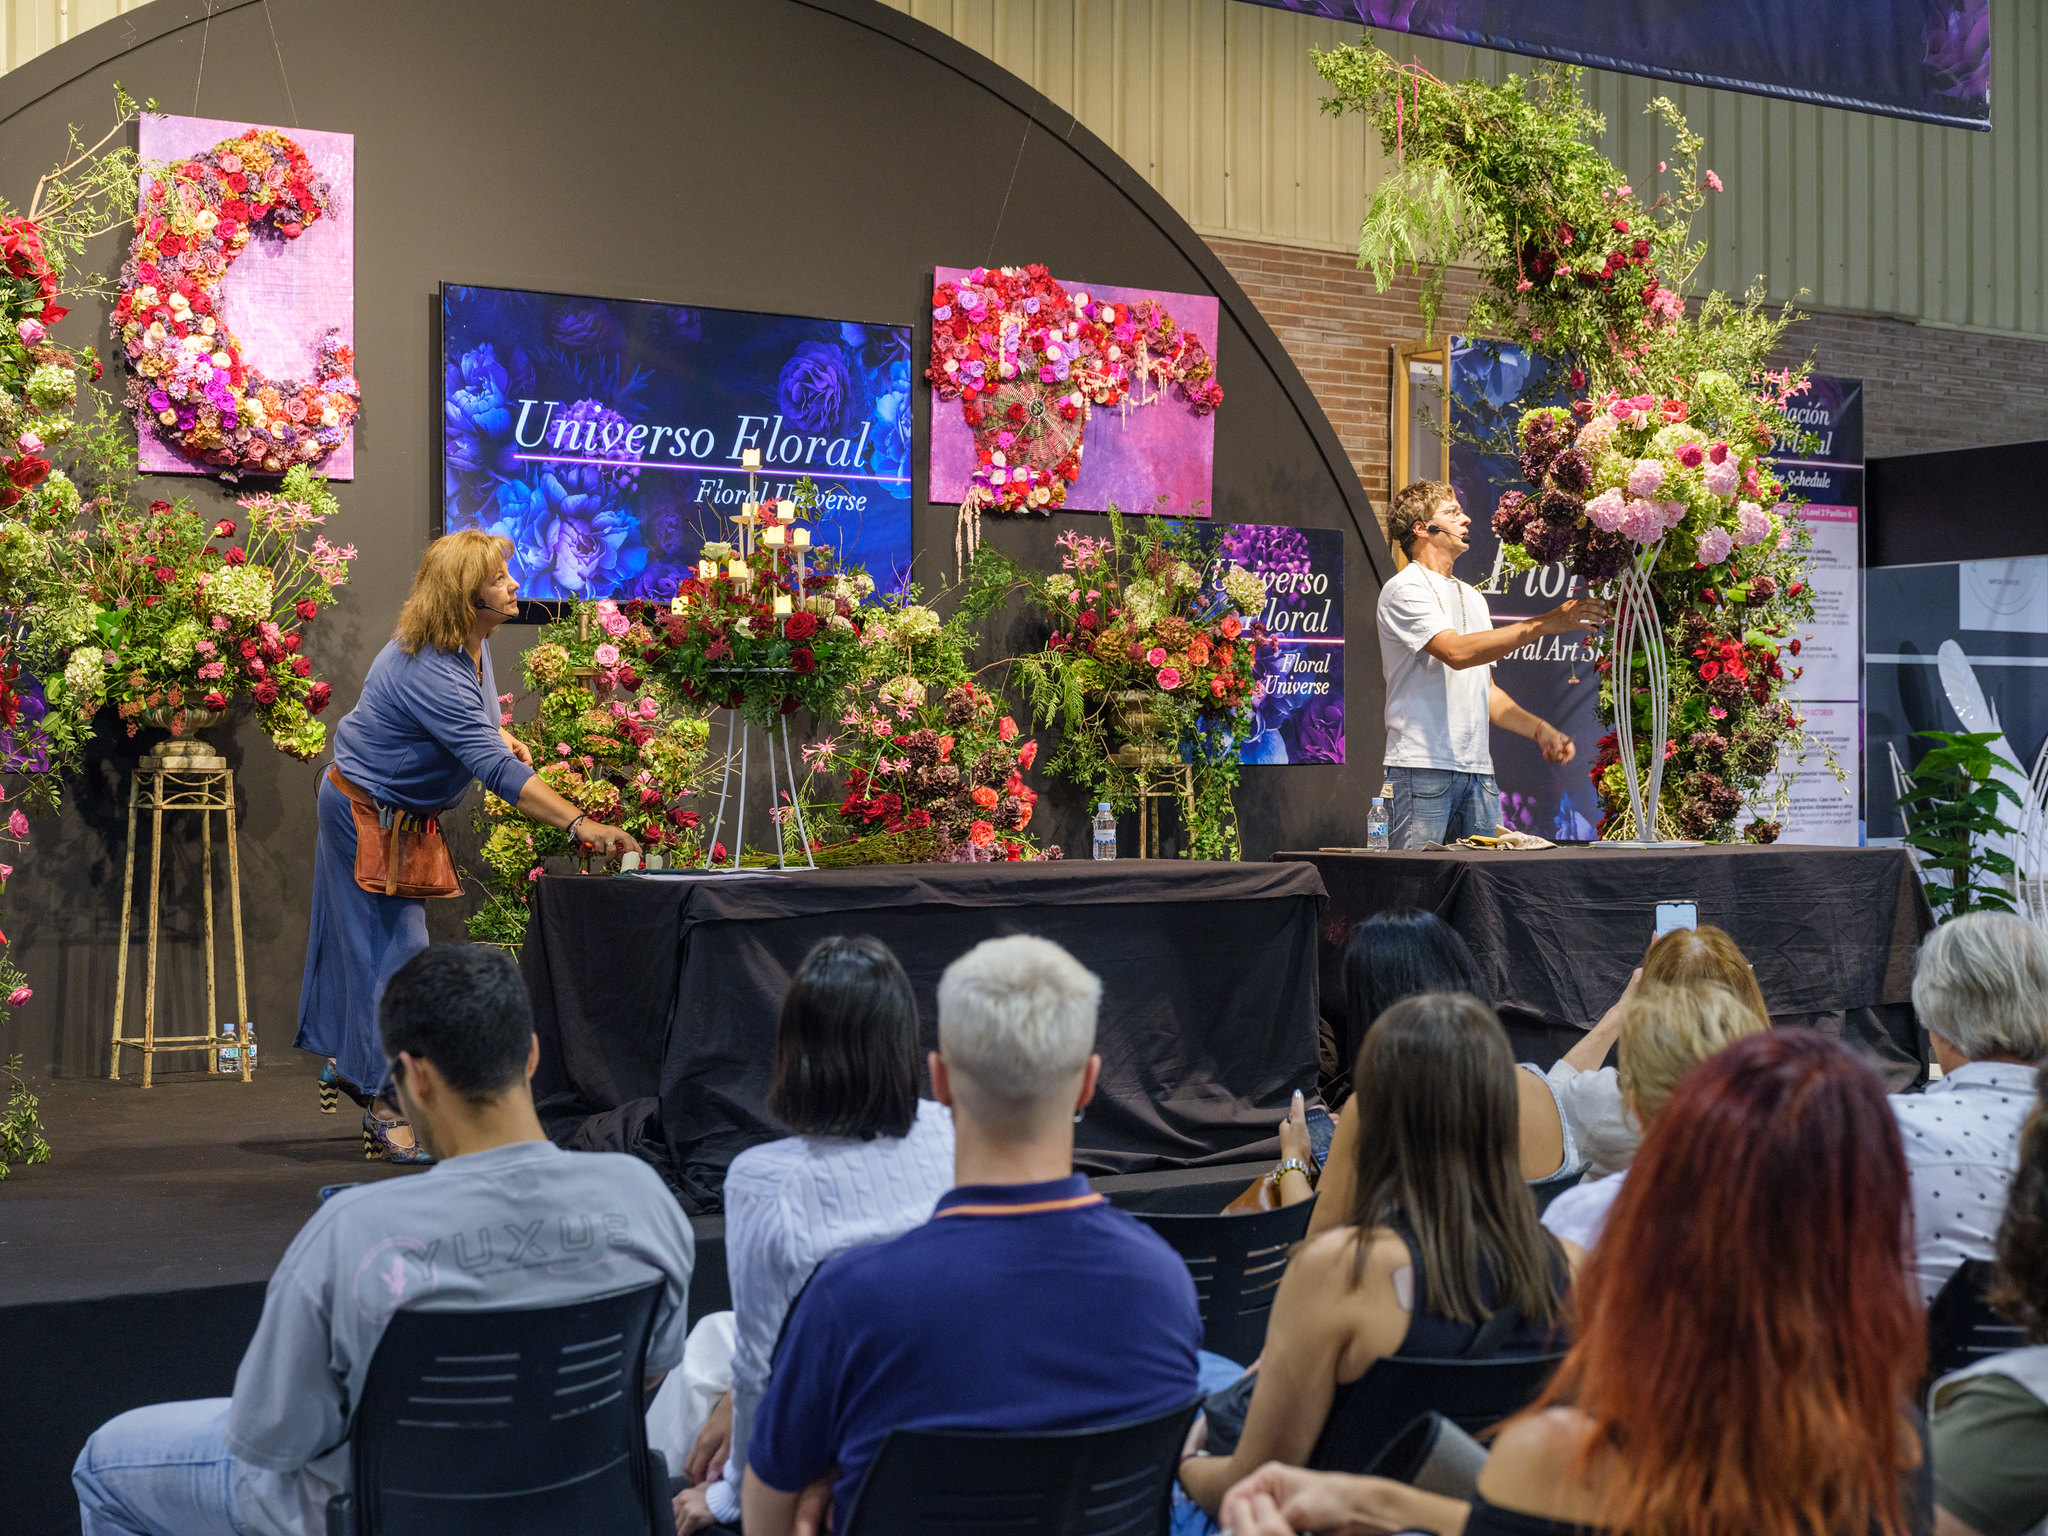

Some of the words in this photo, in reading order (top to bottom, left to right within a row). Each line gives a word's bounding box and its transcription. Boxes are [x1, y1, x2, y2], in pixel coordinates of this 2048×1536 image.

[514, 399, 716, 459] Universo
[726, 415, 871, 468] Floral
[1787, 470, 1831, 488] Schedule
[1211, 558, 1329, 595] Uverso
[1544, 635, 1580, 662] Art
[1280, 653, 1331, 674] Floral
[1265, 675, 1330, 695] Universe
